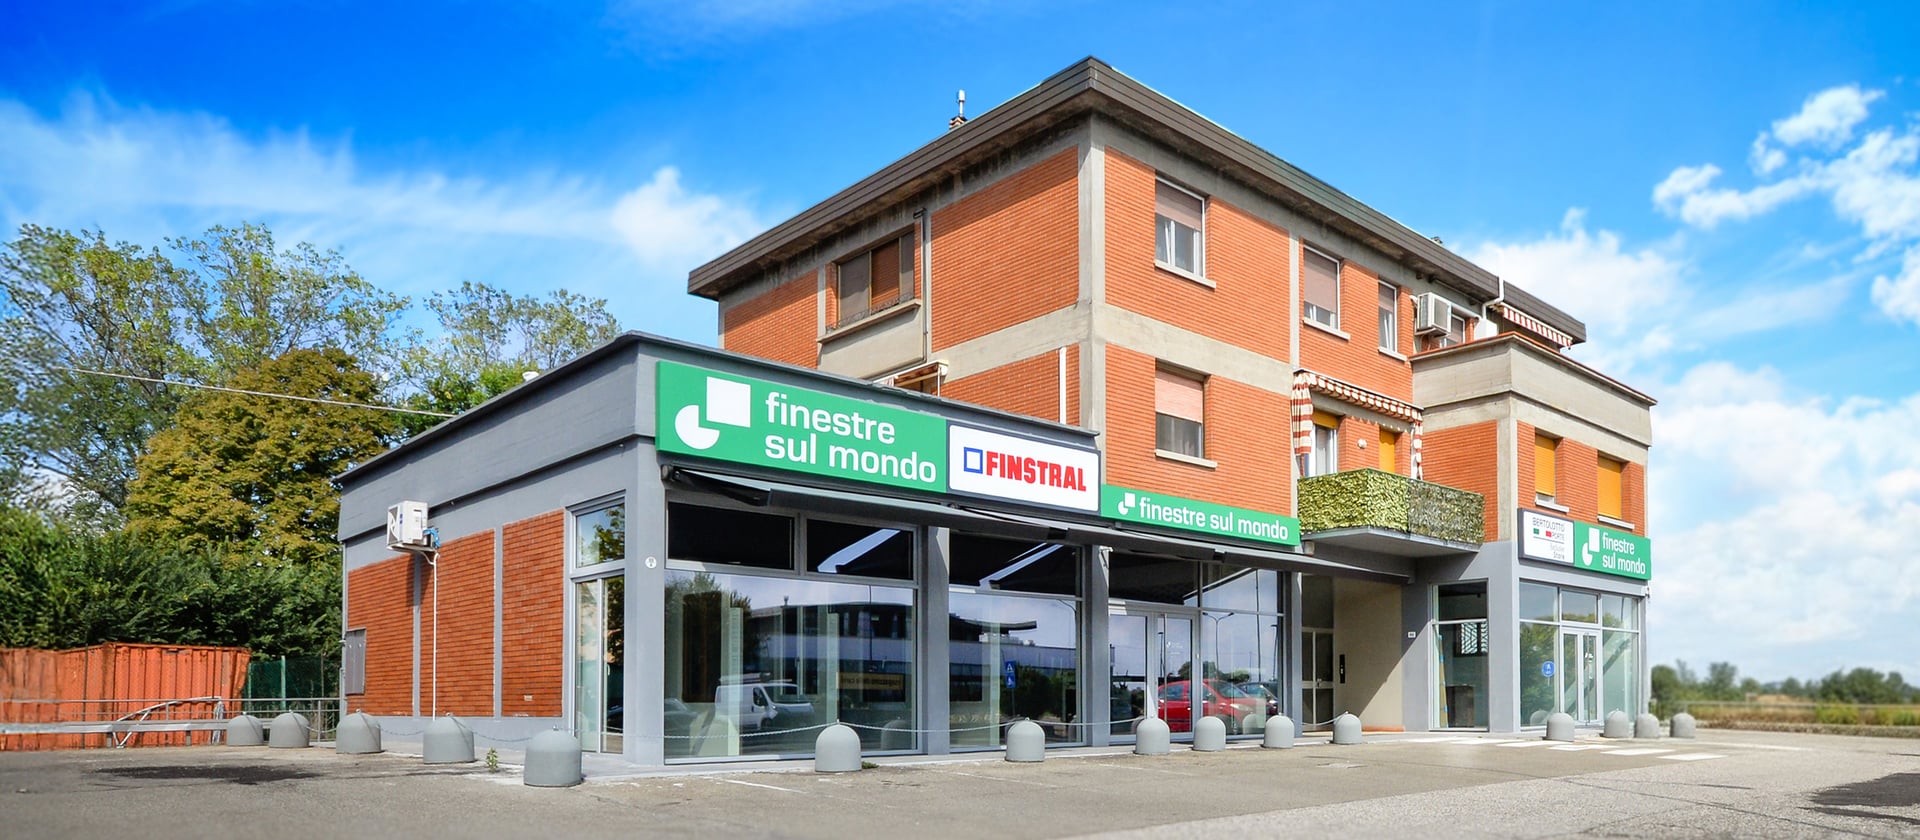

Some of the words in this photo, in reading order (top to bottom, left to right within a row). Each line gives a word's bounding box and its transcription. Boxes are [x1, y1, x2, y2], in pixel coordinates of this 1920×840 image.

[765, 391, 896, 445] finestre
[765, 432, 817, 465] sul
[829, 444, 937, 483] mondo
[986, 450, 1087, 492] FINSTRAL
[1139, 496, 1206, 527] finestre
[1209, 511, 1234, 532] sul
[1237, 518, 1289, 541] mondo
[1532, 516, 1565, 532] BERTOLOTTO
[1602, 531, 1635, 555] finestre
[1602, 552, 1616, 569] sul
[1617, 556, 1646, 575] mondo
